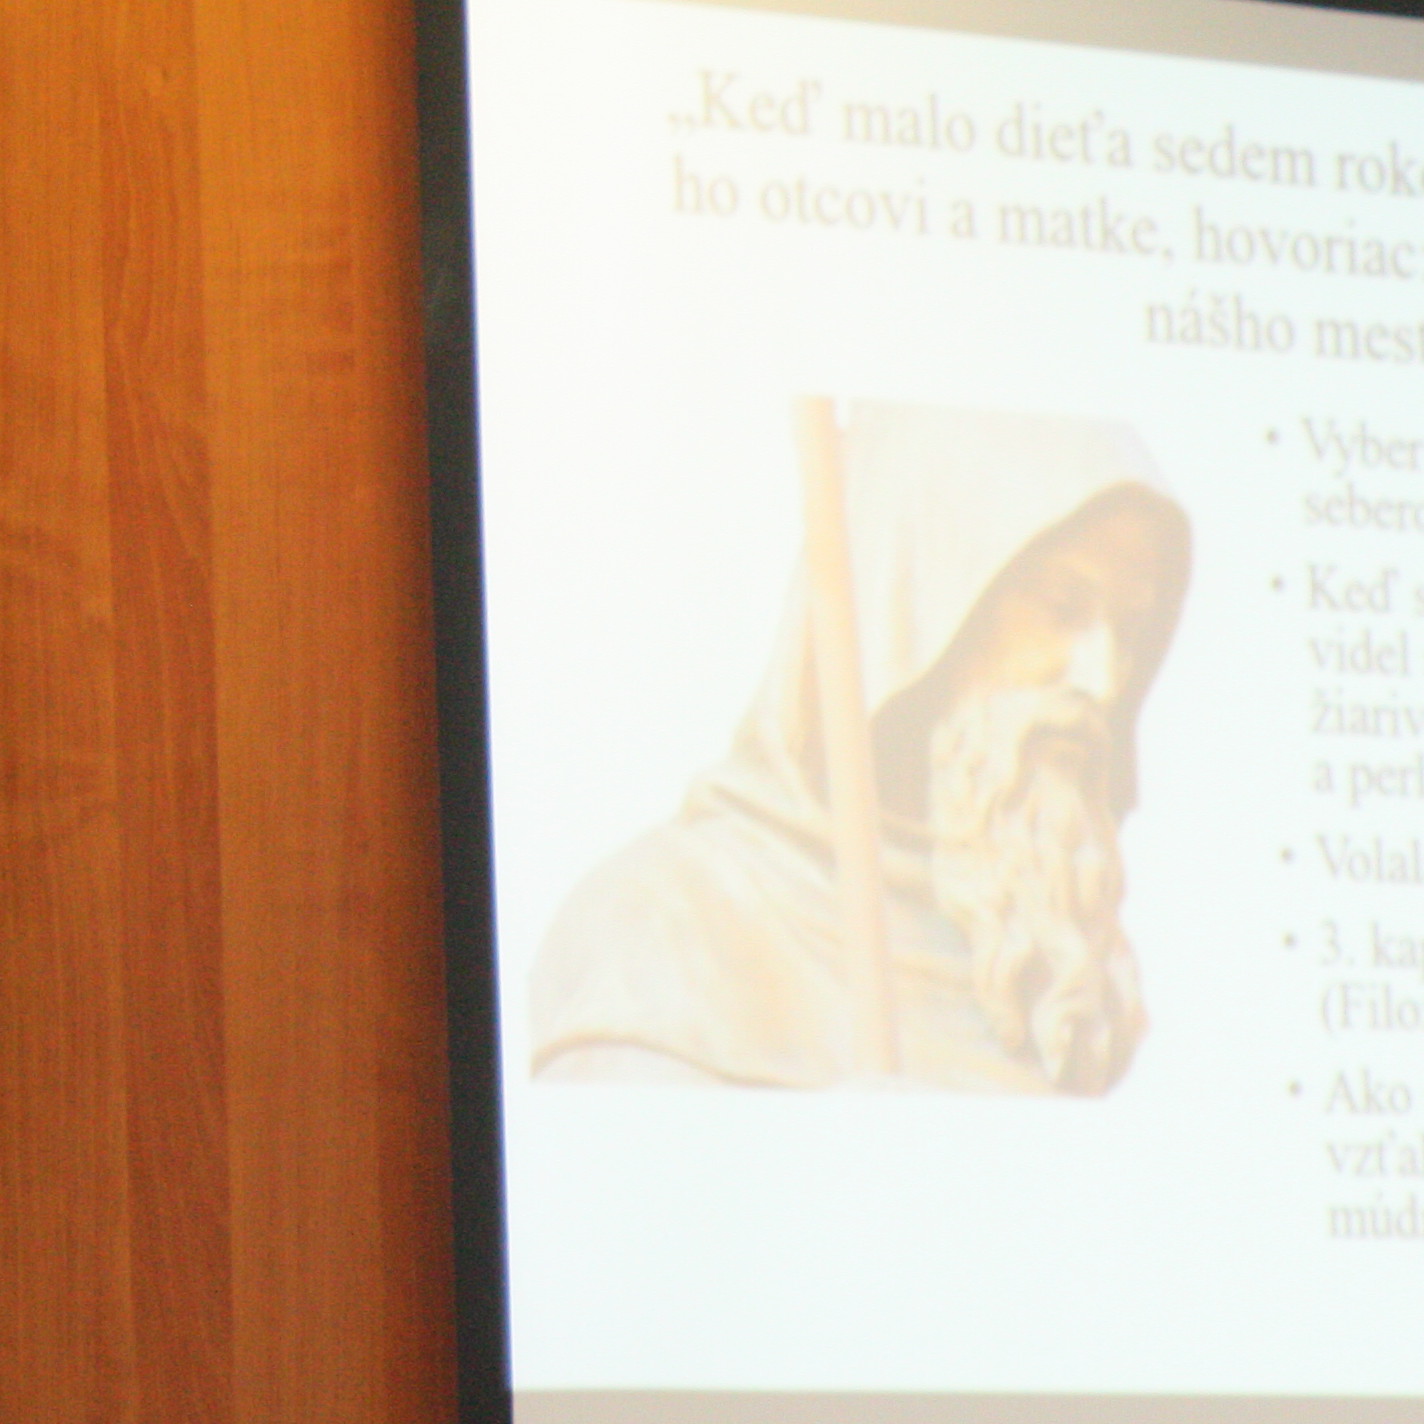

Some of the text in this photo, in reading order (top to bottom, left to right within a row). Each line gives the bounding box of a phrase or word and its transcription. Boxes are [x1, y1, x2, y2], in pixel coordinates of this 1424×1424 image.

[842, 92, 975, 152] malo
[995, 101, 1131, 169] dieťa
[1153, 123, 1316, 189] sedem
[672, 155, 738, 217] ho
[759, 171, 928, 237] otcovi
[950, 194, 977, 240] a
[997, 194, 1173, 261] matke,
[1143, 291, 1295, 356] nášho
[1307, 562, 1397, 613] Keď
[1309, 628, 1408, 678] videl
[1310, 759, 1332, 793] a
[1317, 918, 1355, 968] 3.
[1323, 1066, 1411, 1115] Ako
